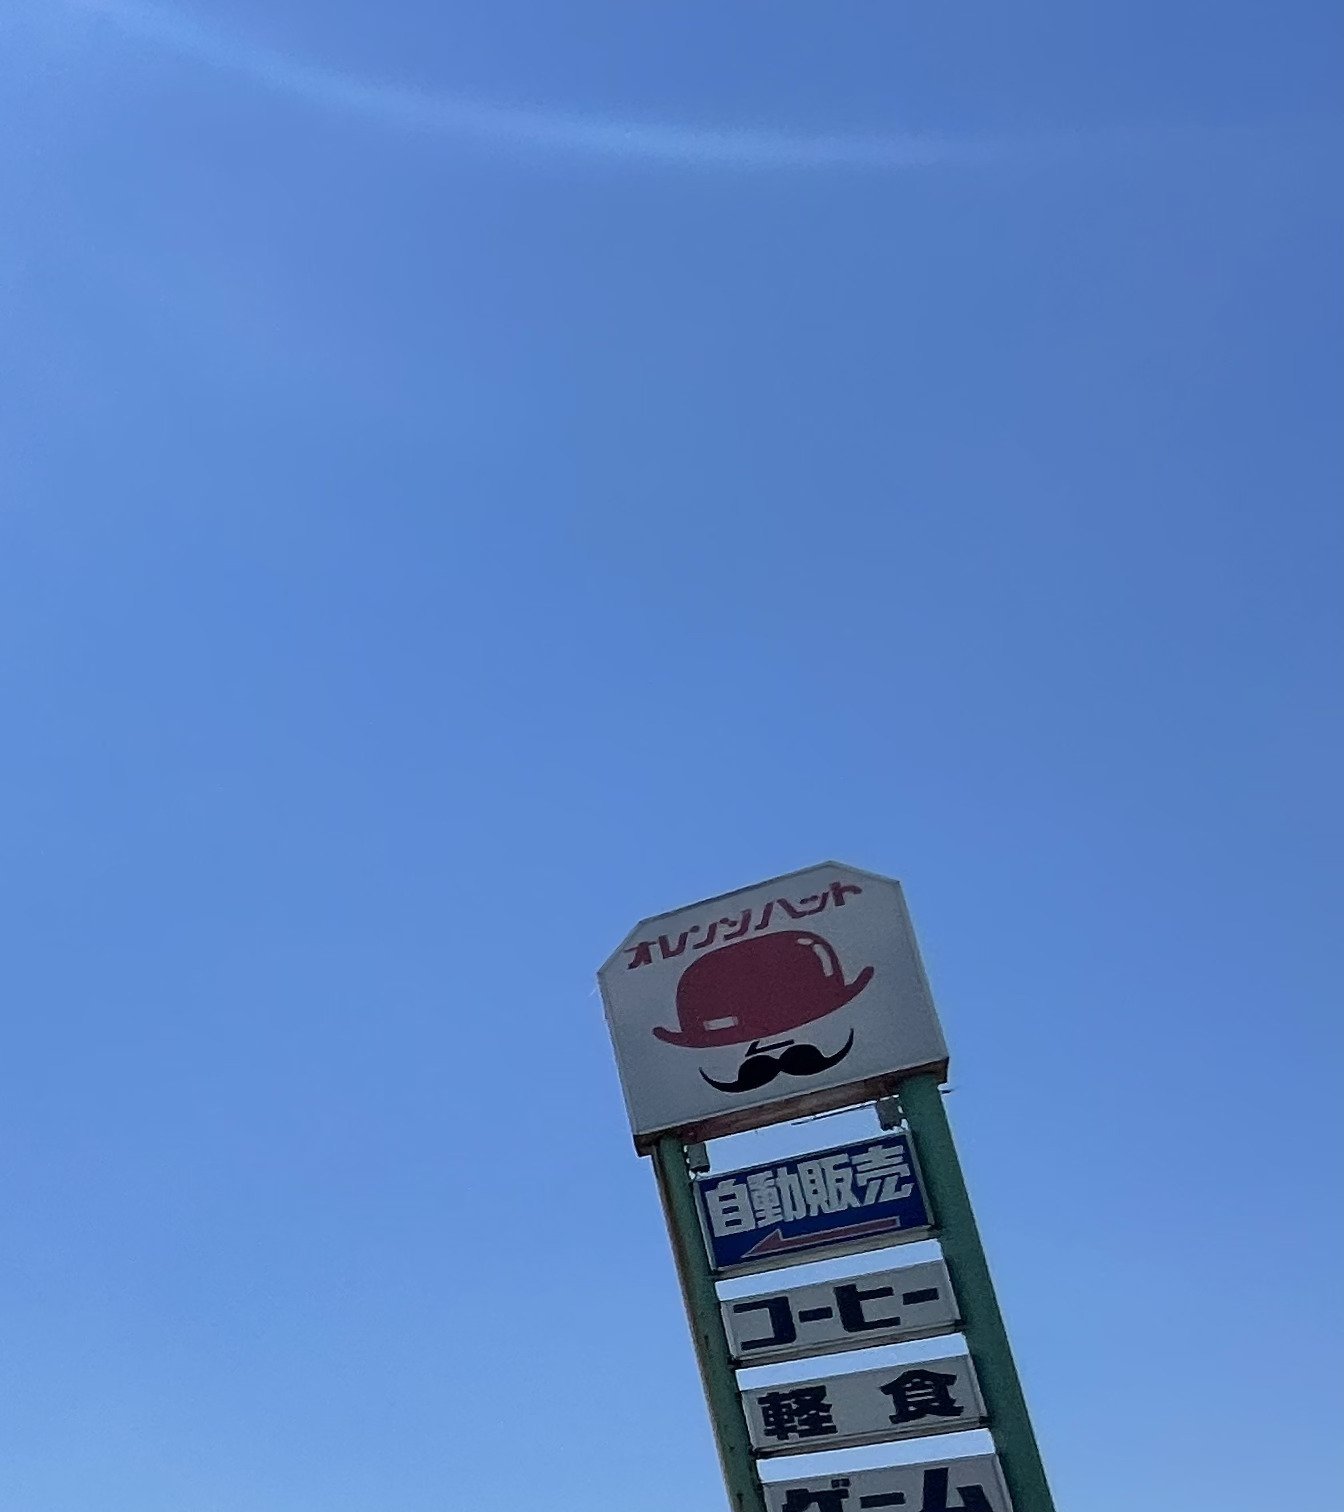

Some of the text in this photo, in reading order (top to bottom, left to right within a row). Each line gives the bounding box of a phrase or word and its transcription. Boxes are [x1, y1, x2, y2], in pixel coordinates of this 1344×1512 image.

[705, 1144, 916, 1237] 自動販売
[732, 1284, 941, 1351] コーヒー
[757, 1369, 964, 1440] 軽食
